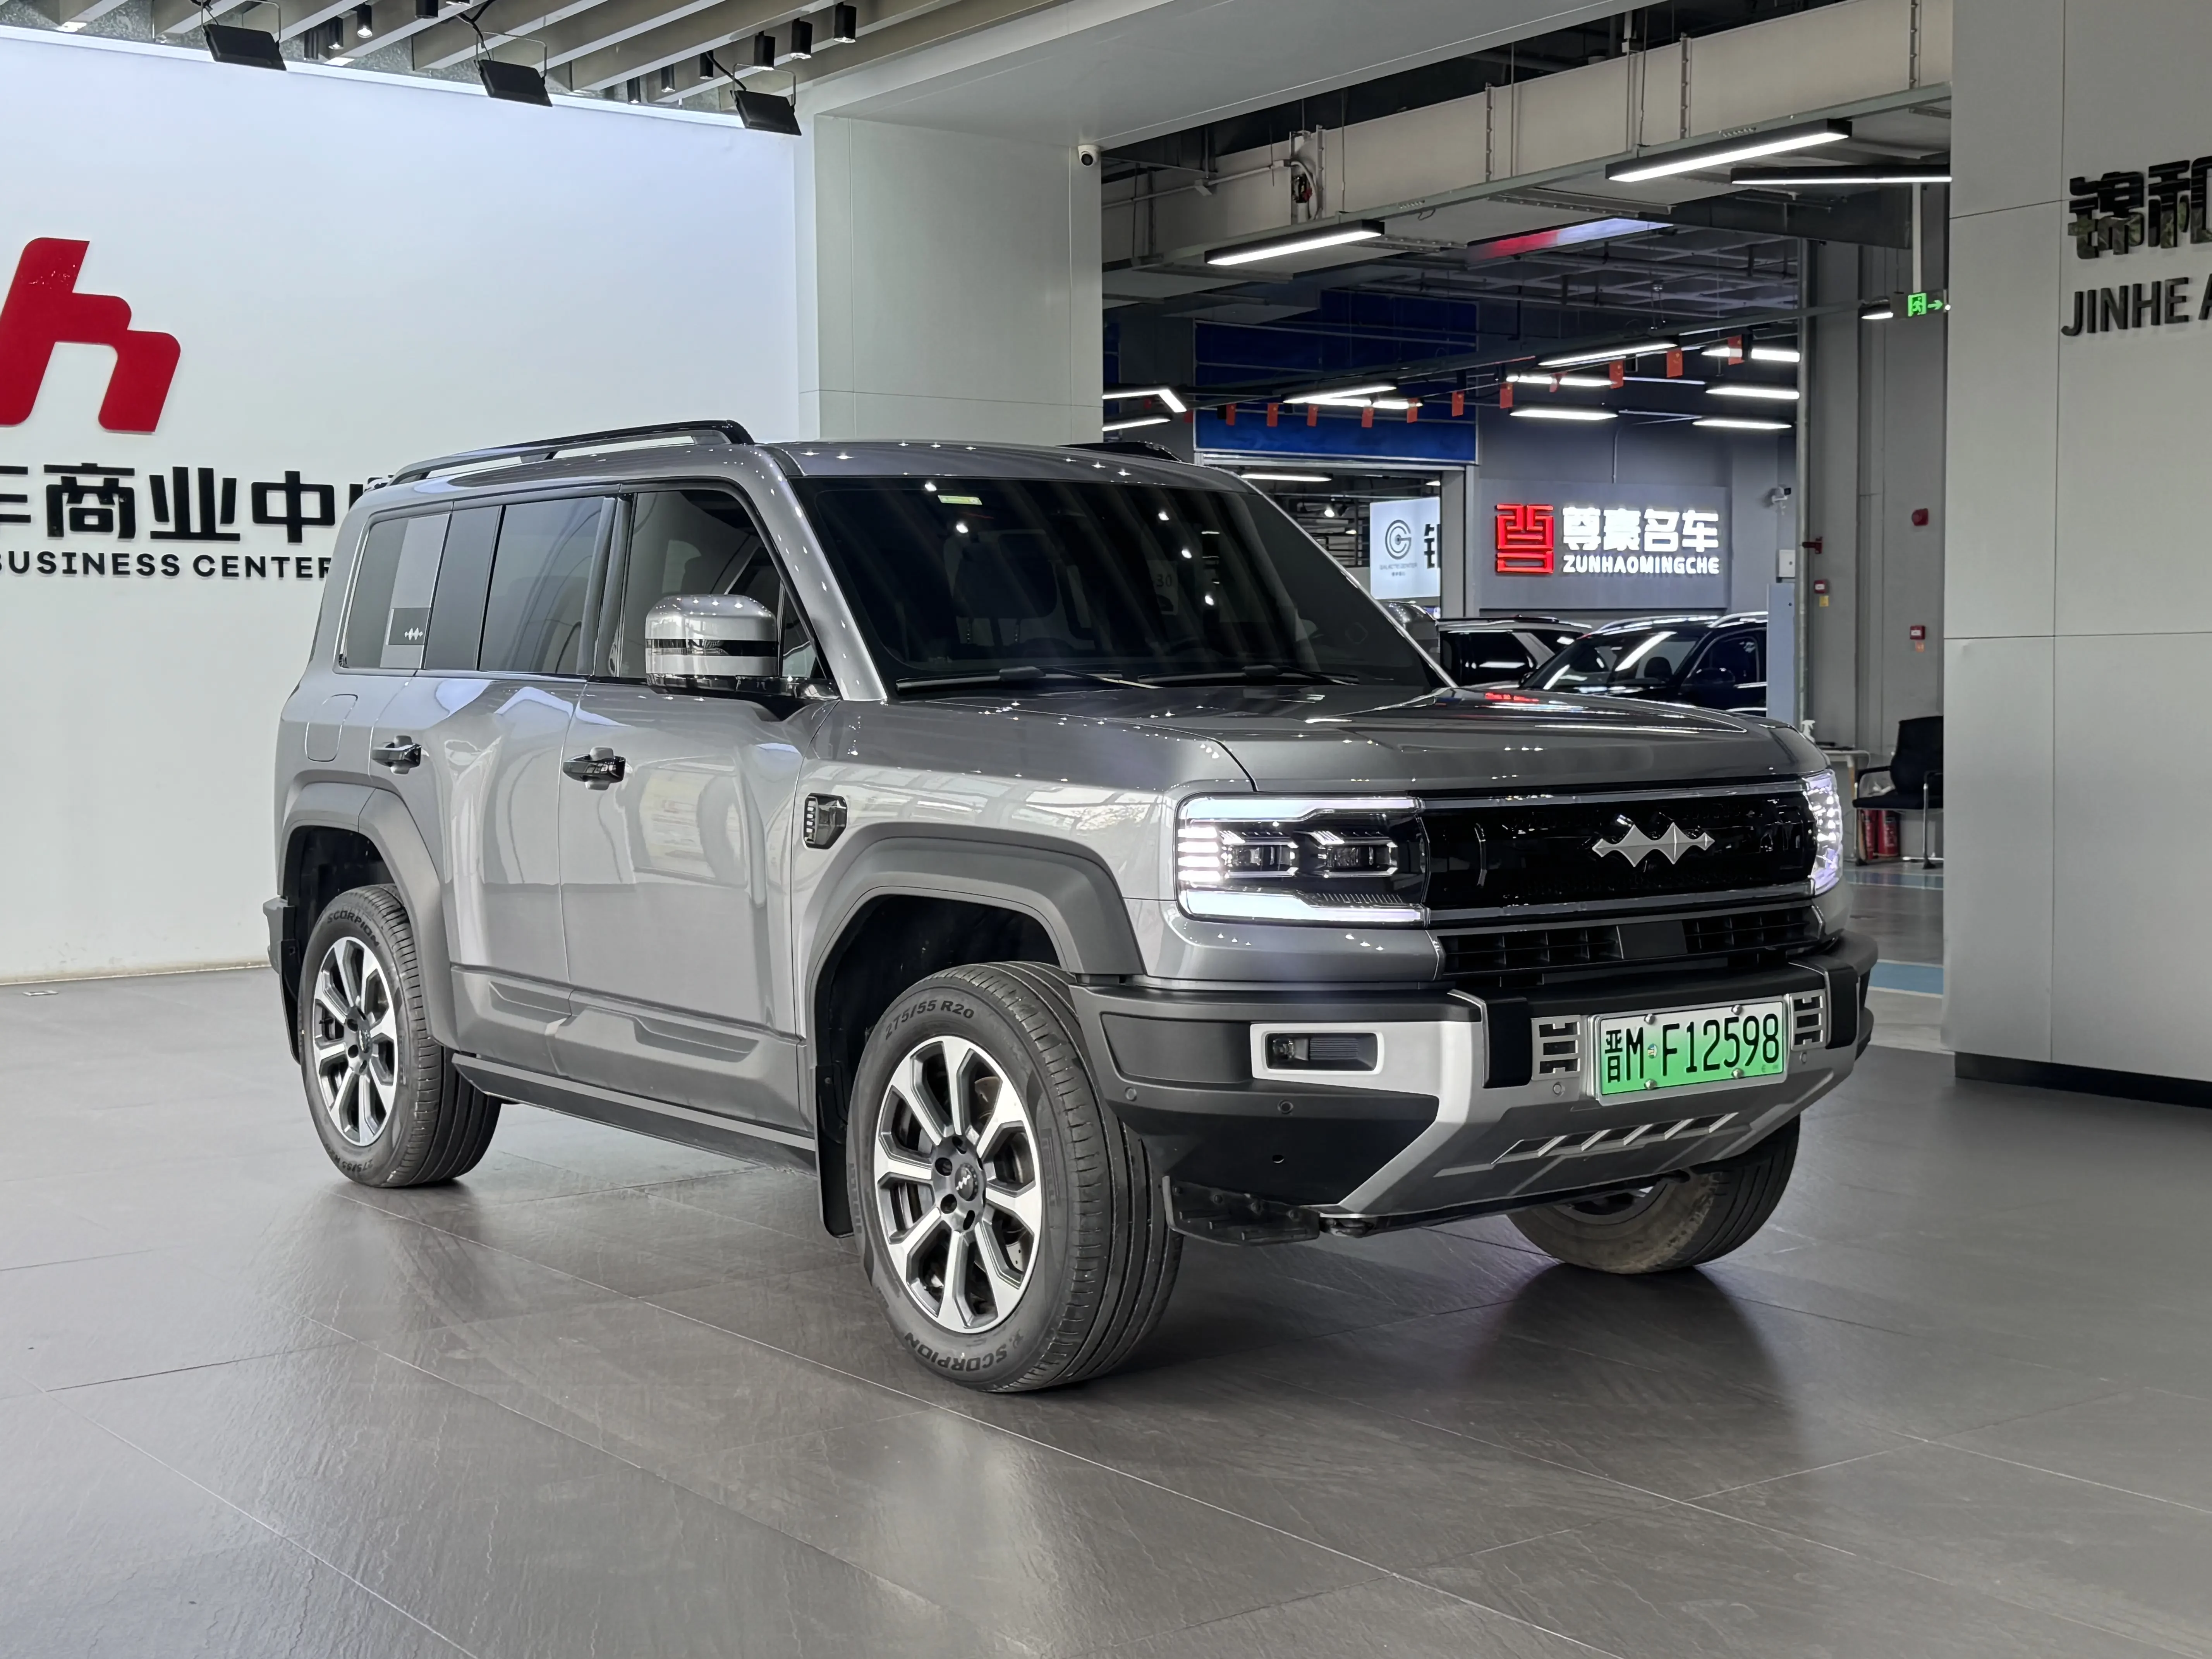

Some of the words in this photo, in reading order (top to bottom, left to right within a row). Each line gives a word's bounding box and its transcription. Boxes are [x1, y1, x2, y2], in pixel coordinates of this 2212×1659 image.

[2061, 277, 2189, 336] JINHE
[0, 463, 392, 543] 商业中
[1563, 507, 1719, 552] 尊豪名车
[0, 551, 180, 577] USINESS
[1563, 555, 1719, 574] ZUNHAOMINGCHE
[327, 910, 380, 947] SCORPION
[885, 1000, 938, 1040] 275/55
[940, 1000, 974, 1019] R20
[904, 1332, 1007, 1372] SCORPION
